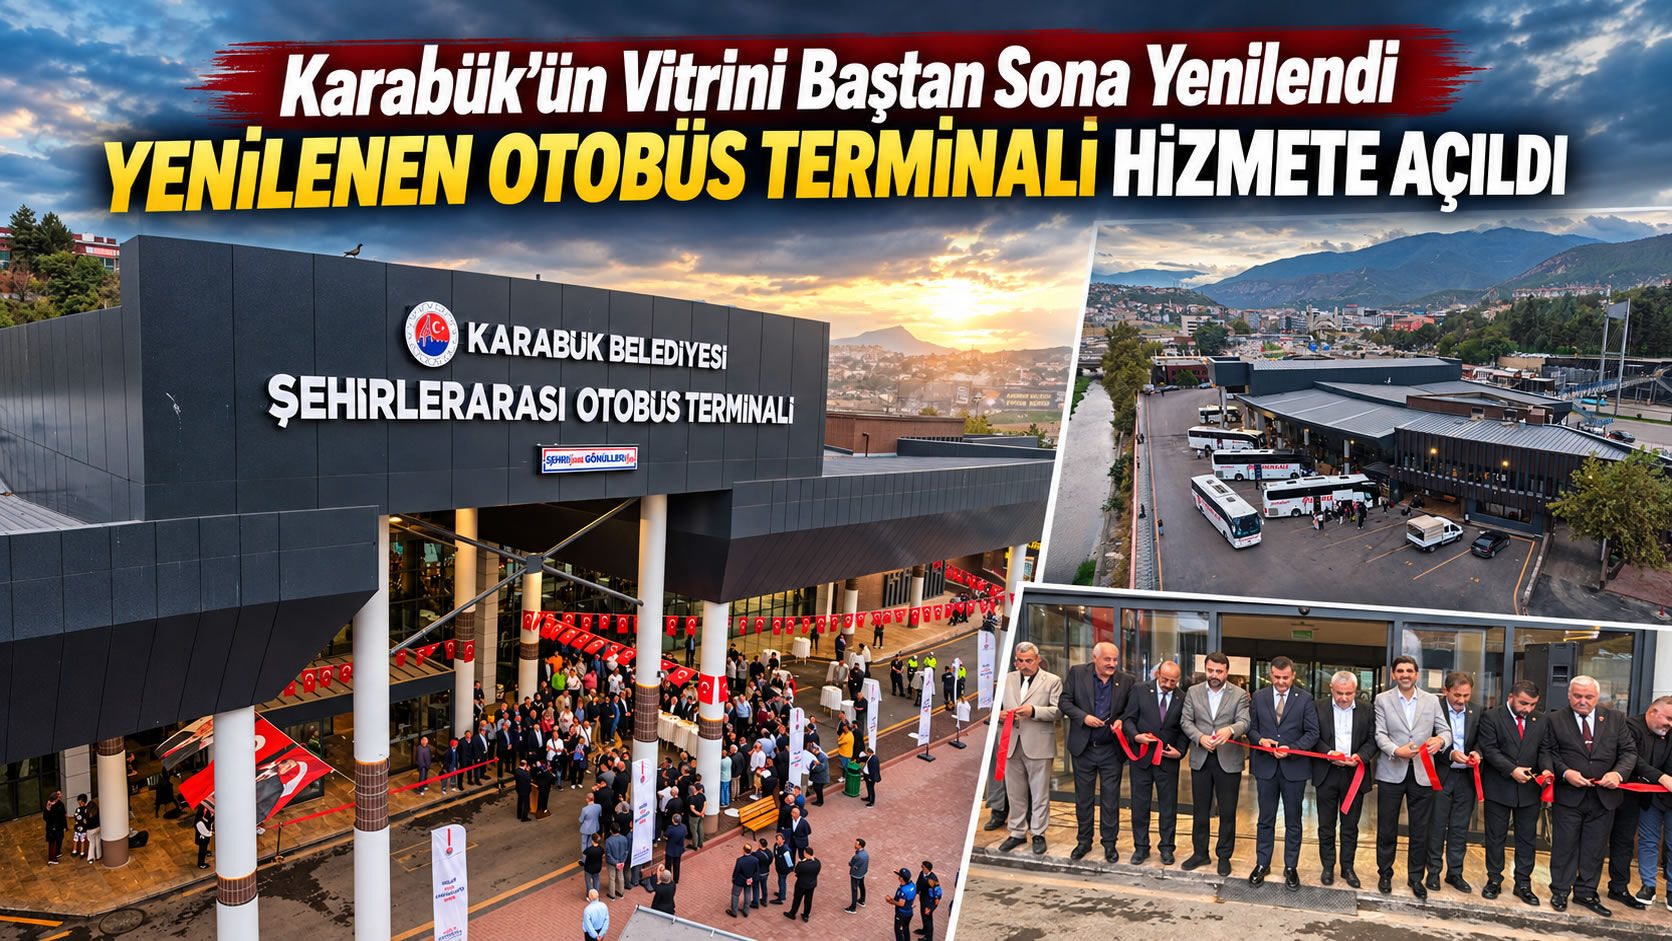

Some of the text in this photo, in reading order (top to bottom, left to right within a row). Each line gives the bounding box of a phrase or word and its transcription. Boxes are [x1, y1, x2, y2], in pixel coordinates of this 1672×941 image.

[467, 321, 604, 362] KARABÜK
[609, 334, 728, 370] BELEDİYESİ
[267, 373, 795, 429] ŞEHİRLERARASI OTOBÜS TERMİNALİ
